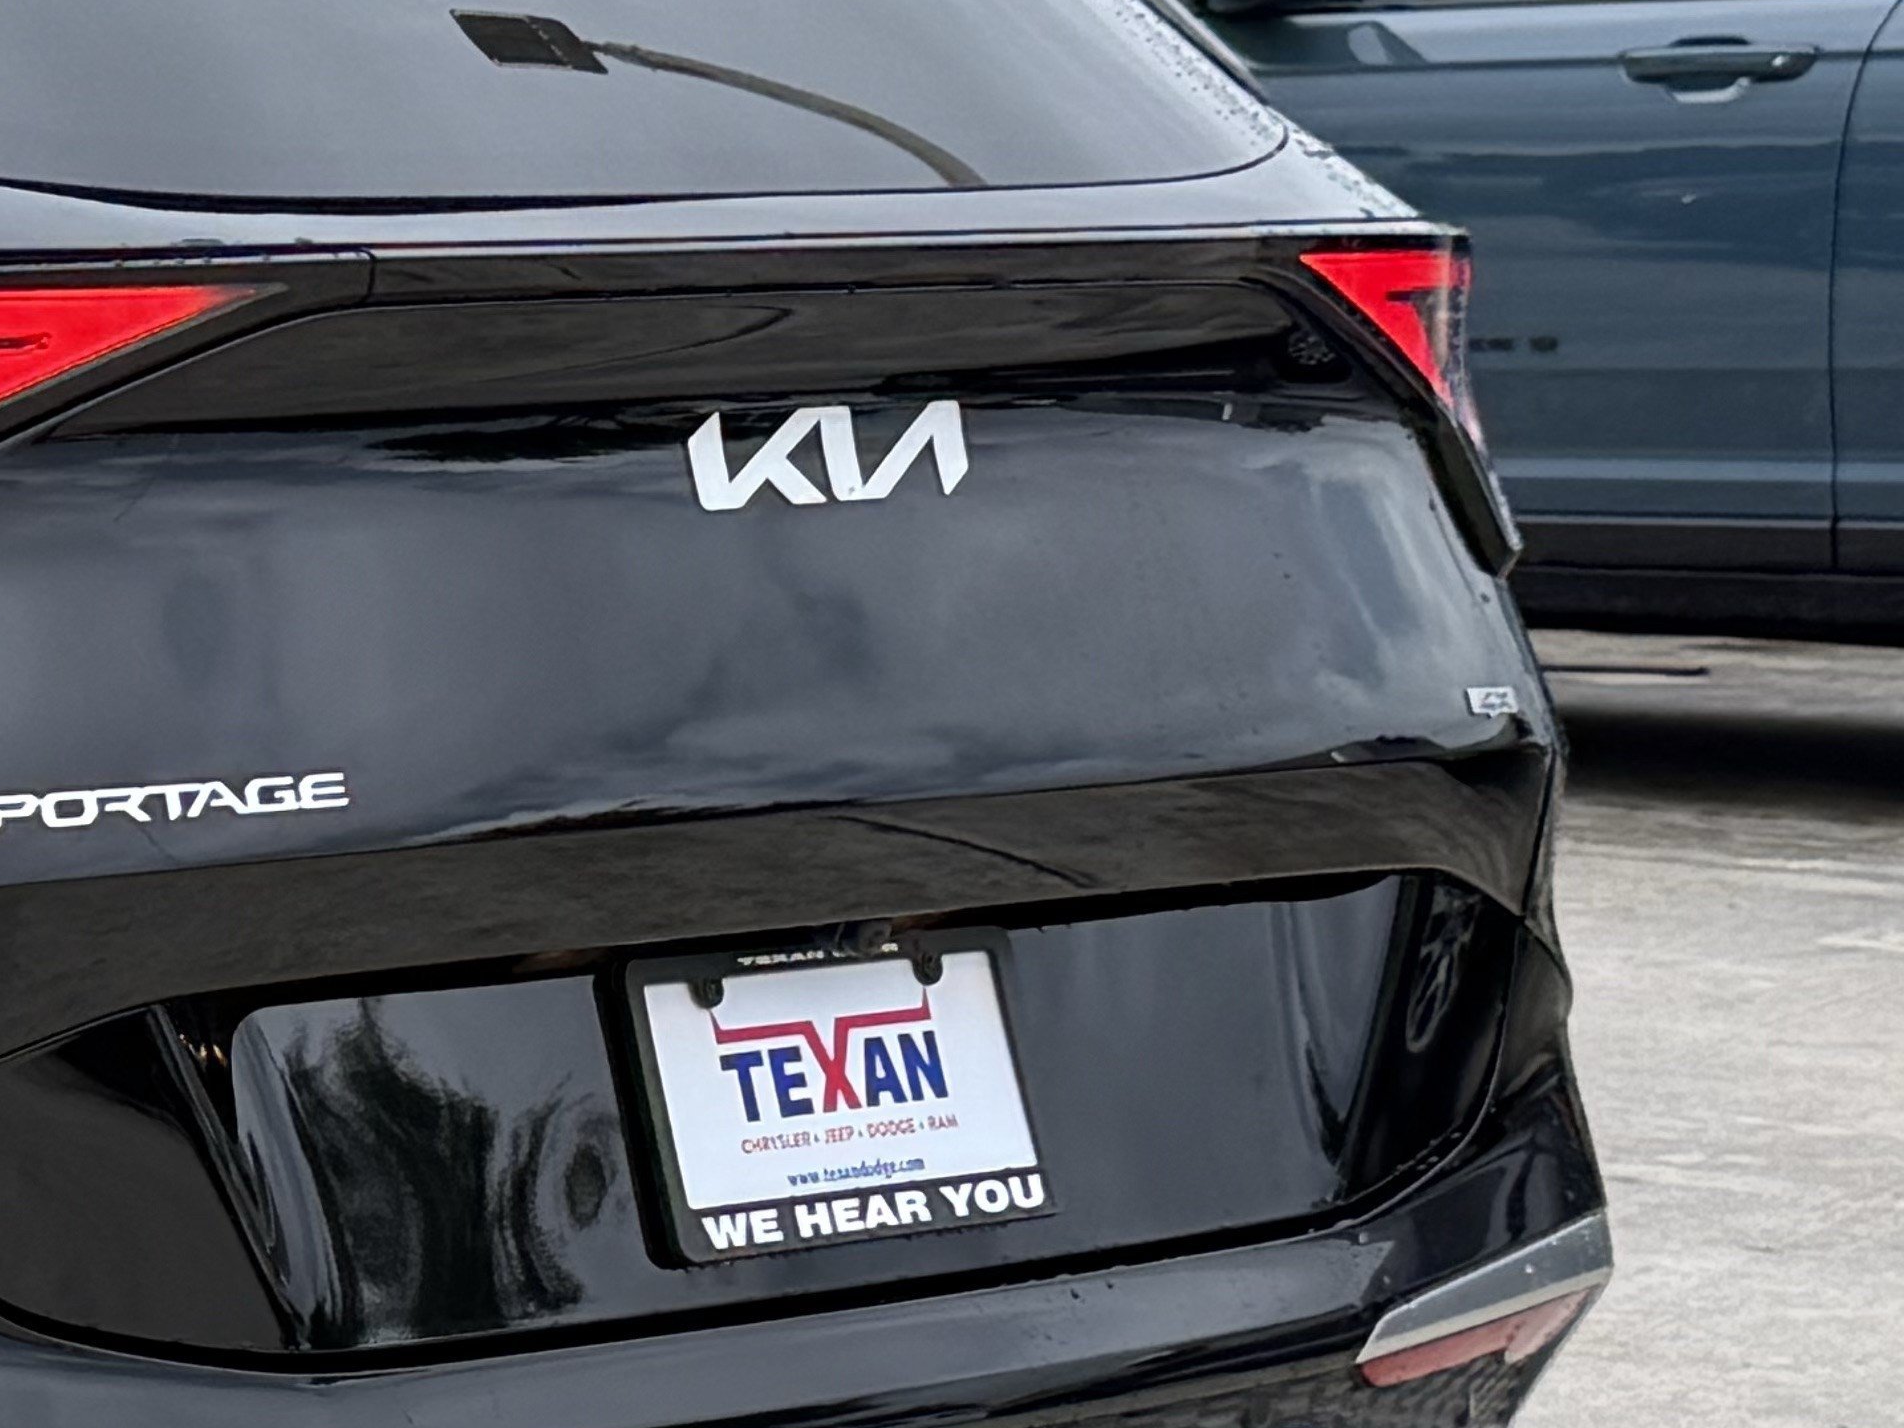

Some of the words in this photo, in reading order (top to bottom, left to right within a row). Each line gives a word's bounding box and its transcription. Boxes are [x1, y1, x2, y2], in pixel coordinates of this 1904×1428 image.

[688, 400, 969, 511] KIA
[716, 1017, 949, 1123] TEXAN
[866, 1117, 916, 1139] DODGE
[927, 1113, 959, 1132] RAM
[701, 1209, 784, 1251] WE
[794, 1190, 933, 1239] HEAR
[938, 1172, 1046, 1218] YOU
